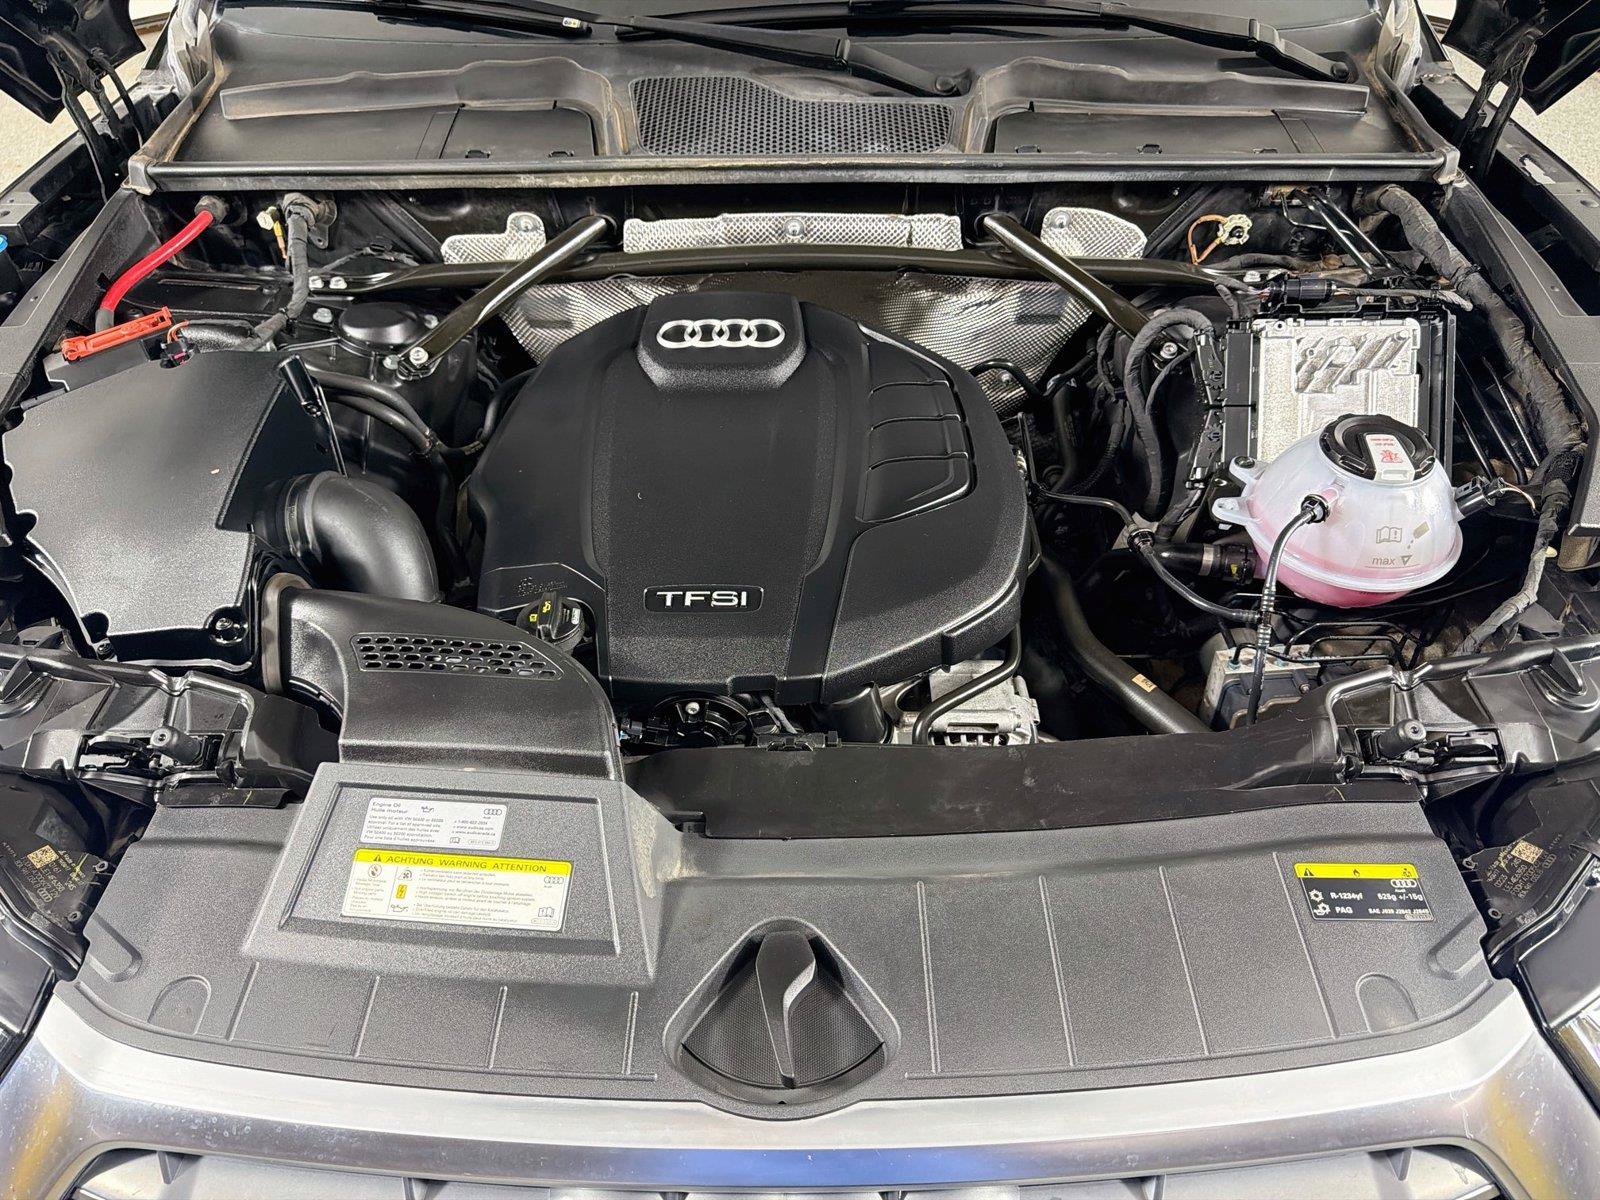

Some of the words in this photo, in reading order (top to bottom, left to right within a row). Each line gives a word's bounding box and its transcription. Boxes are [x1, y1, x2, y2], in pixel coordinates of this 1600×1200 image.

[1372, 555, 1396, 566] max
[656, 591, 748, 607] TFSI
[386, 856, 434, 865] ACHTUNG
[439, 860, 487, 869] WARNING
[492, 862, 546, 872] ATTENTION
[1335, 906, 1353, 914] PAG
